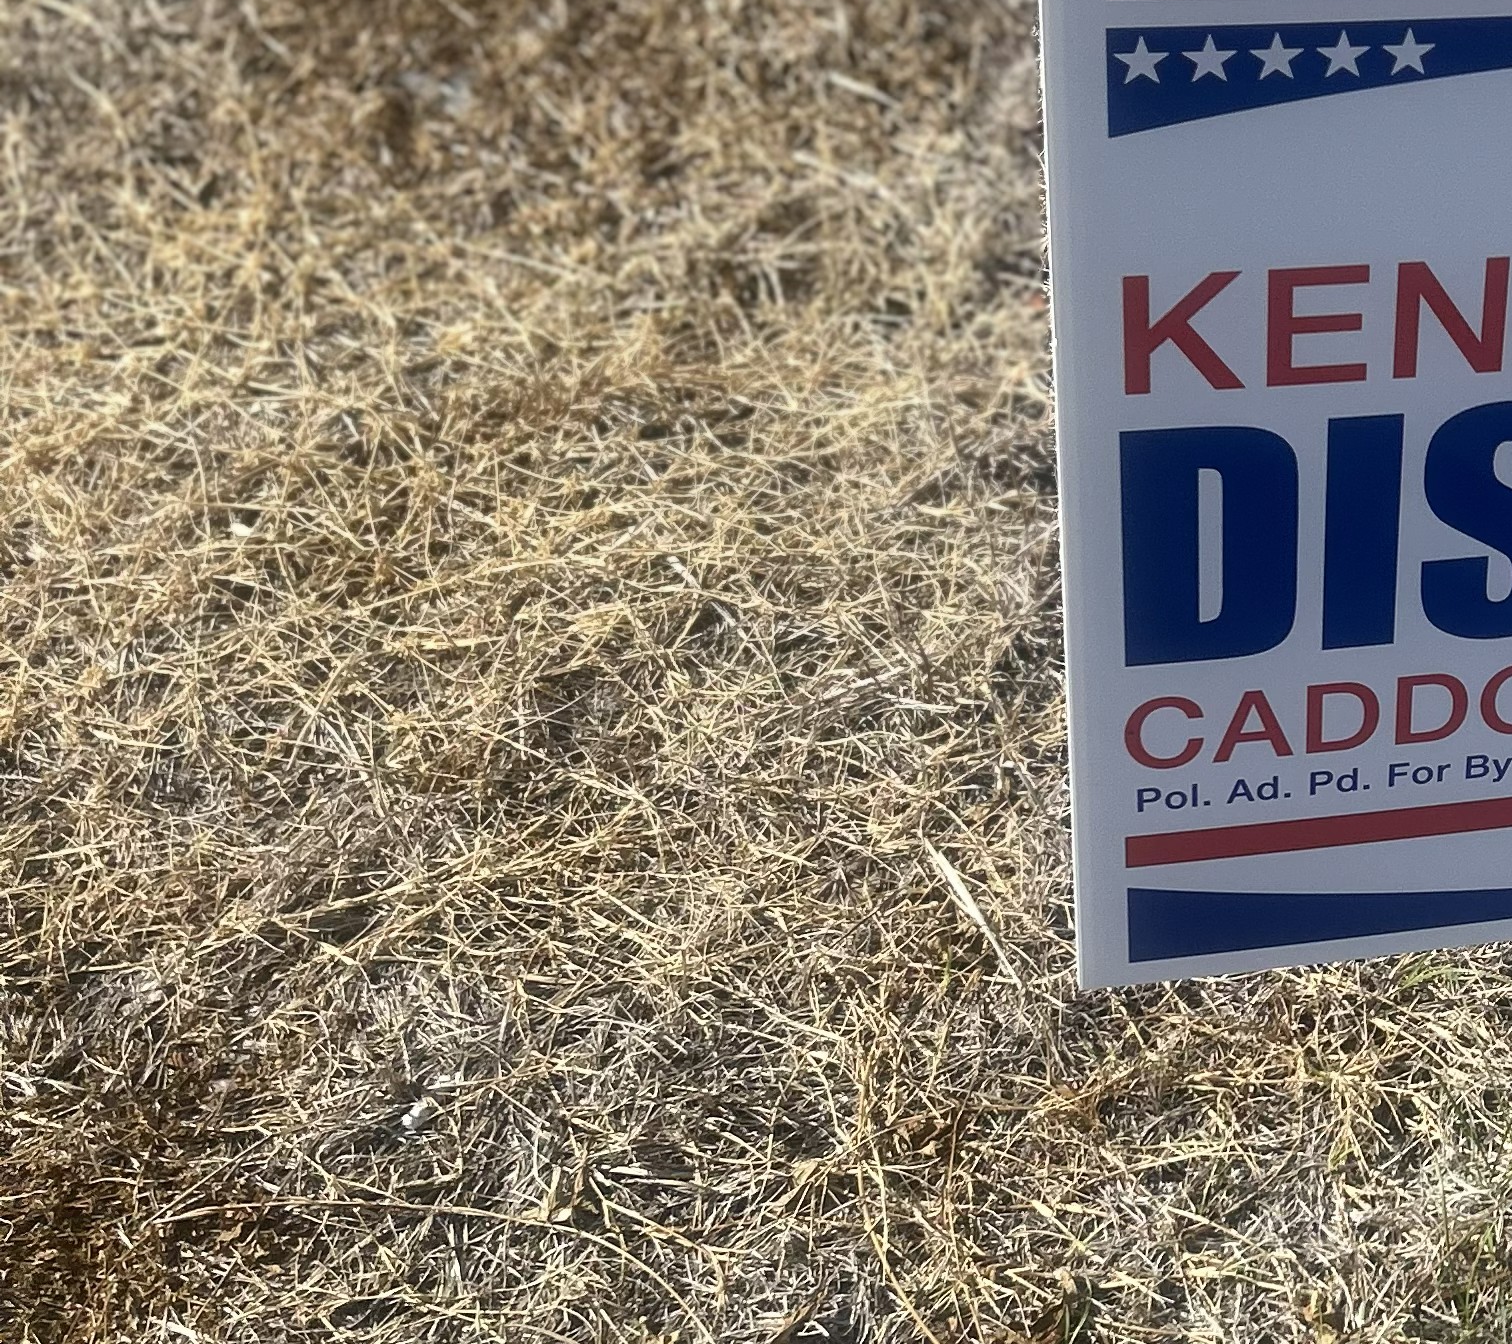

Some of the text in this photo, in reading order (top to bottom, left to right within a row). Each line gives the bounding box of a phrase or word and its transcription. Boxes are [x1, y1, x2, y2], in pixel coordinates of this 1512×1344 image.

[1136, 783, 1211, 813] Pol.
[1226, 775, 1292, 805] Ad.
[1309, 767, 1371, 796] Pd.
[1388, 761, 1452, 788] For
[1465, 754, 1512, 783] By
